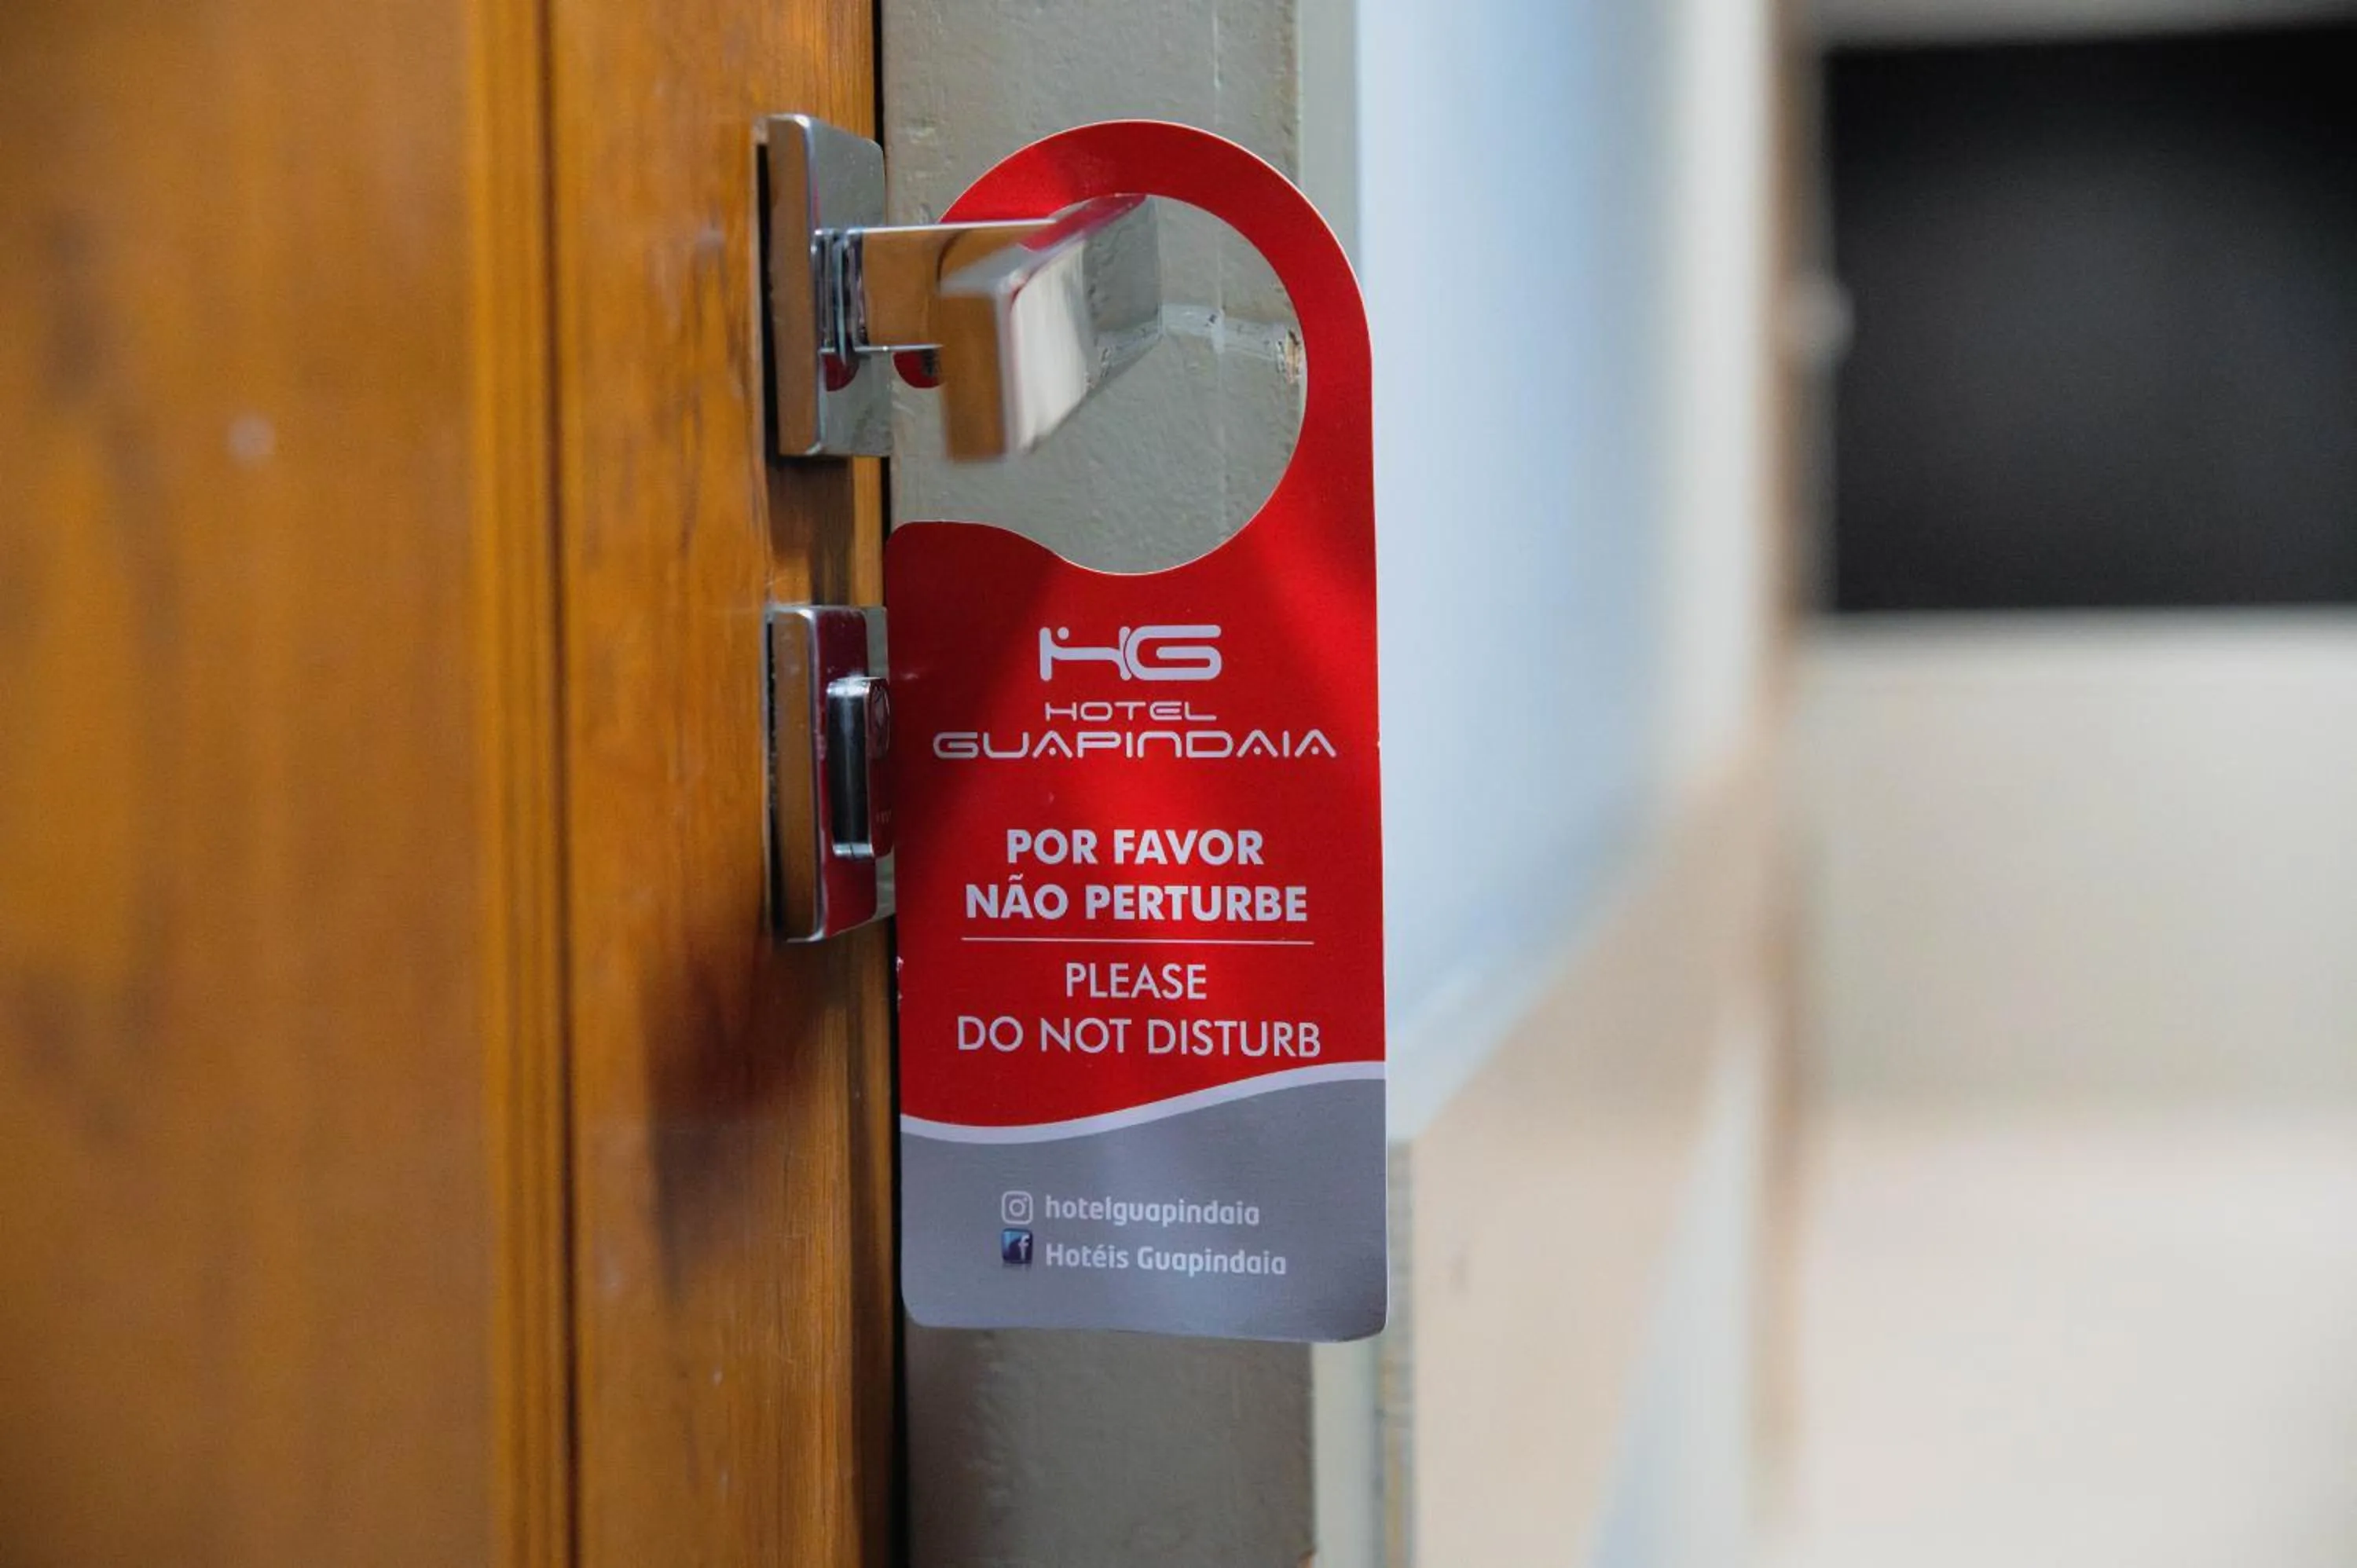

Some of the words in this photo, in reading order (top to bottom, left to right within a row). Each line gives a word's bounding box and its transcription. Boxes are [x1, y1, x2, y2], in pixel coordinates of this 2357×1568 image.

[1045, 701, 1217, 721] HOTEL
[933, 728, 1337, 760] GUAPINDAIA
[1006, 828, 1098, 865] POR
[1113, 829, 1264, 866] FAVOR
[966, 874, 1069, 920] NÃO
[1085, 885, 1308, 921] PERTURBE
[1066, 962, 1207, 1000] PLEASE
[958, 1016, 1024, 1052] DO
[1040, 1017, 1132, 1053] NOT
[1147, 1019, 1321, 1057] DISTURB
[1045, 1196, 1260, 1228] hotelguapindaia
[1046, 1243, 1130, 1269] Hotéis
[1137, 1245, 1287, 1278] Guapindaia
